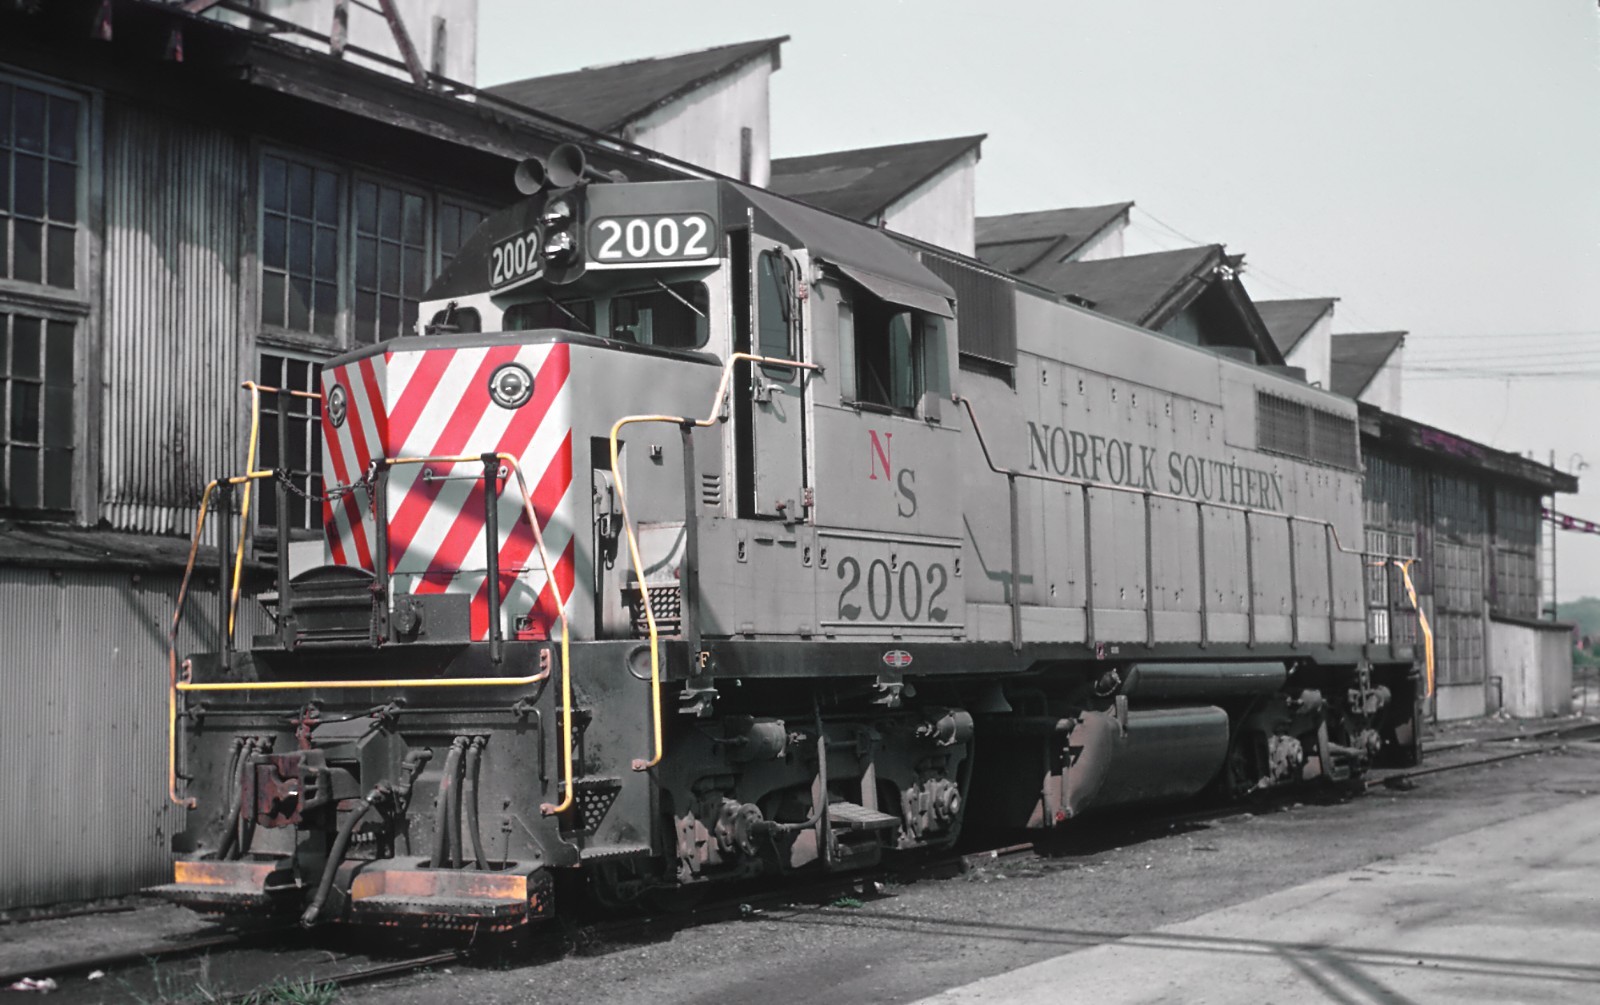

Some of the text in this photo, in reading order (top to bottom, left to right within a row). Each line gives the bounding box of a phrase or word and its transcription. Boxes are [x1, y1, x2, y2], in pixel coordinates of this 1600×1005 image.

[492, 232, 538, 285] 2002
[597, 216, 708, 259] 2002
[868, 429, 893, 482] N
[1027, 421, 1284, 511] NORFOLK SOUTHERN
[896, 468, 918, 518] S
[836, 556, 949, 623] 2002
